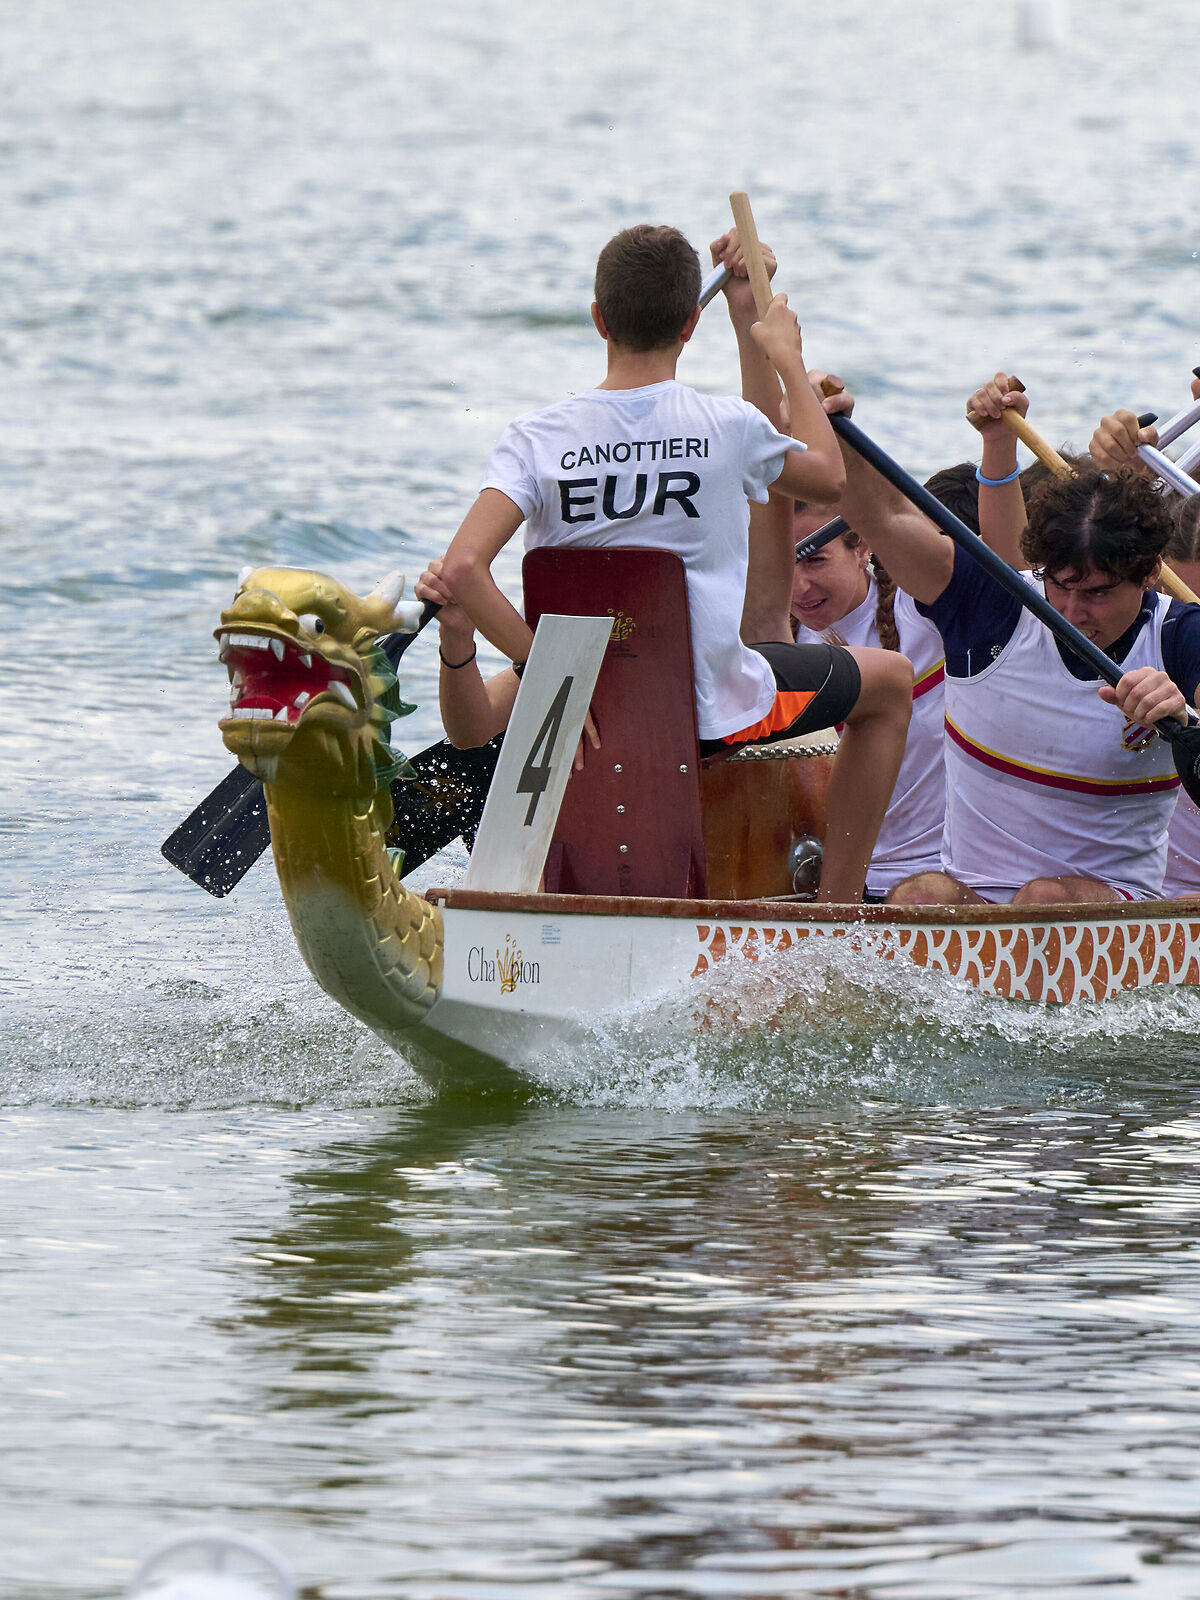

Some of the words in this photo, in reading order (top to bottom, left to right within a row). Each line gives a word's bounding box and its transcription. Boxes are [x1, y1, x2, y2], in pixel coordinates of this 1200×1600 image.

[560, 437, 709, 470] CANOTTIERI
[557, 471, 701, 524] EUR
[516, 675, 574, 827] 4
